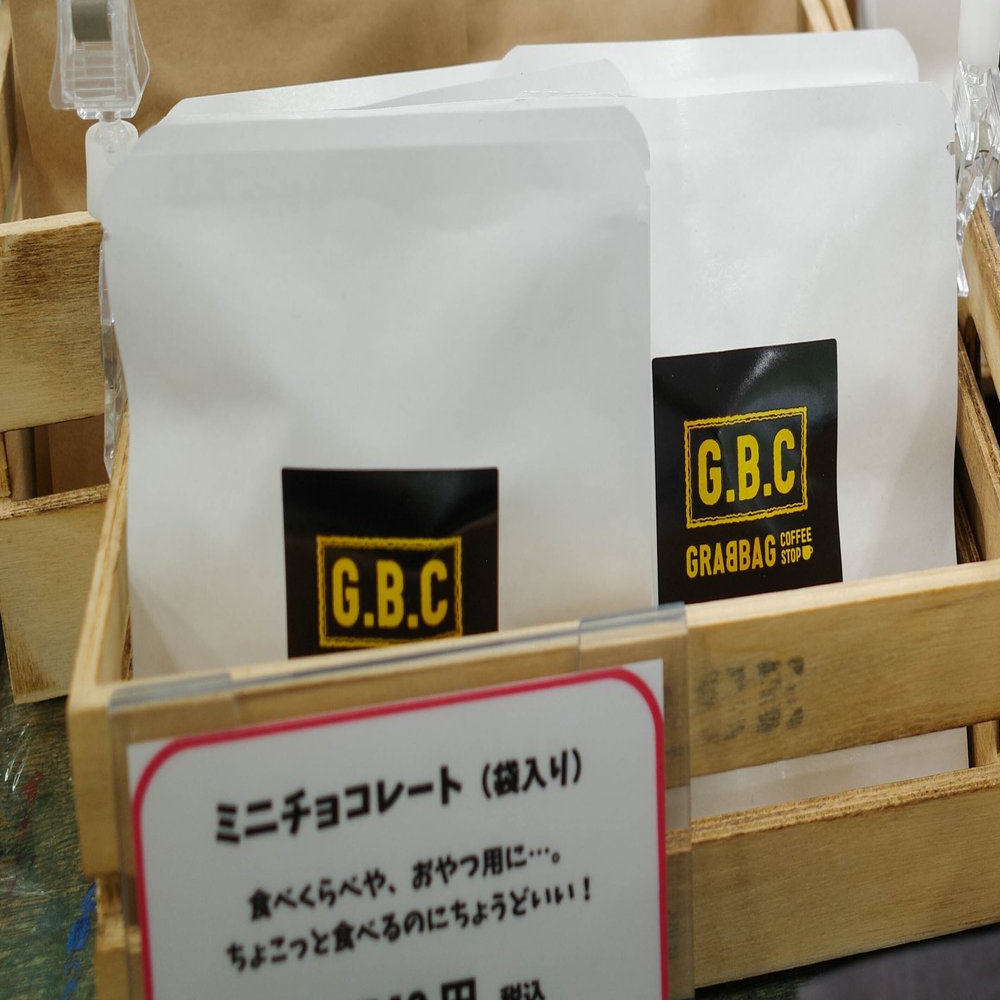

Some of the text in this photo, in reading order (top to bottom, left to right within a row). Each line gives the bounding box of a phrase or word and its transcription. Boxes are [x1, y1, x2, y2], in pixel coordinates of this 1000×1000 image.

[698, 429, 795, 505] G.B.C
[687, 535, 776, 578] GRABBAG
[781, 527, 812, 547] COFFEE
[781, 547, 801, 564] STOP
[333, 558, 447, 627] G.B.C
